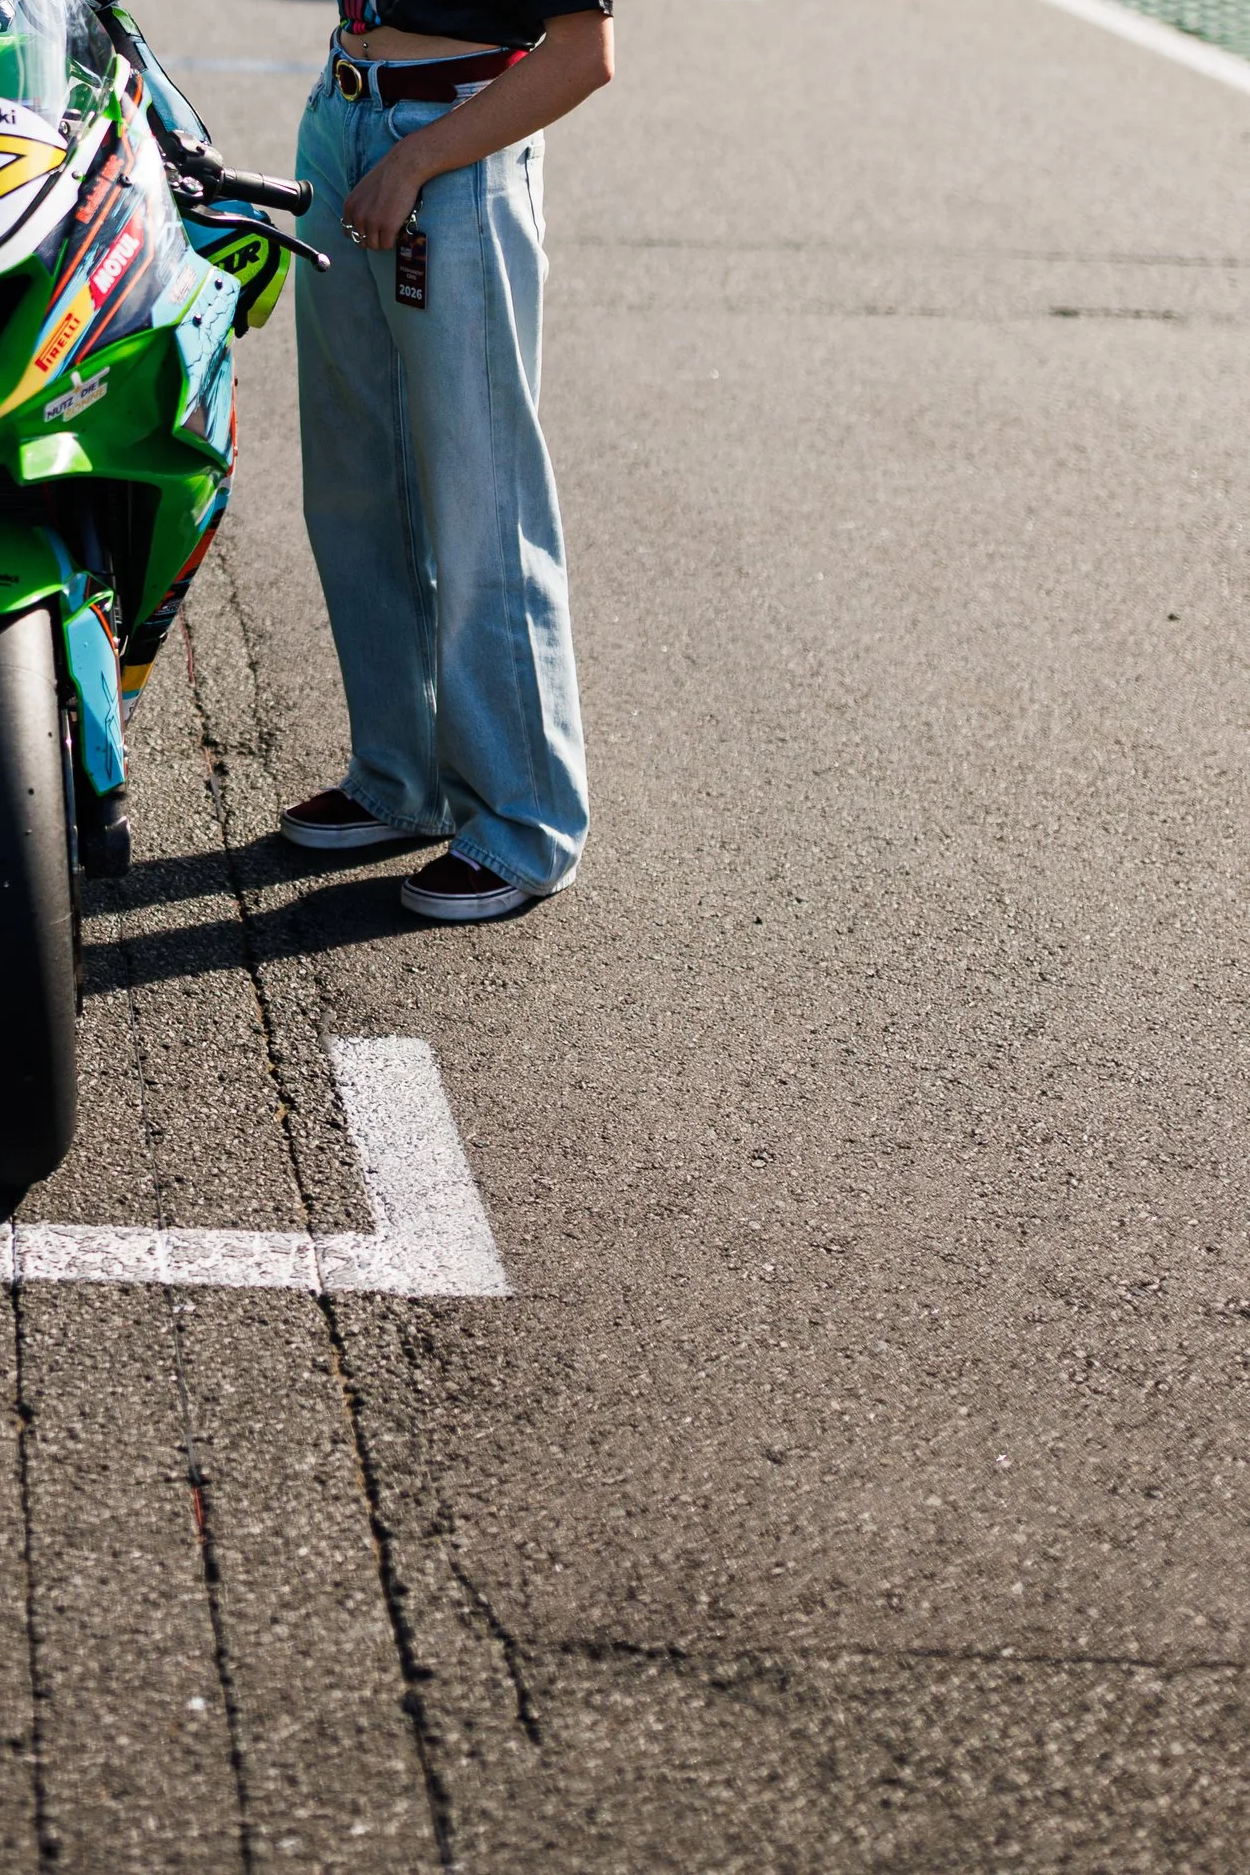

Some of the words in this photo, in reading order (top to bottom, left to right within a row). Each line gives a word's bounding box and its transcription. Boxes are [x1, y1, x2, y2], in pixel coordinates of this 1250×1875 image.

[92, 232, 141, 294] MOTUL
[399, 284, 423, 300] 2026
[35, 312, 82, 373] PIRELLI
